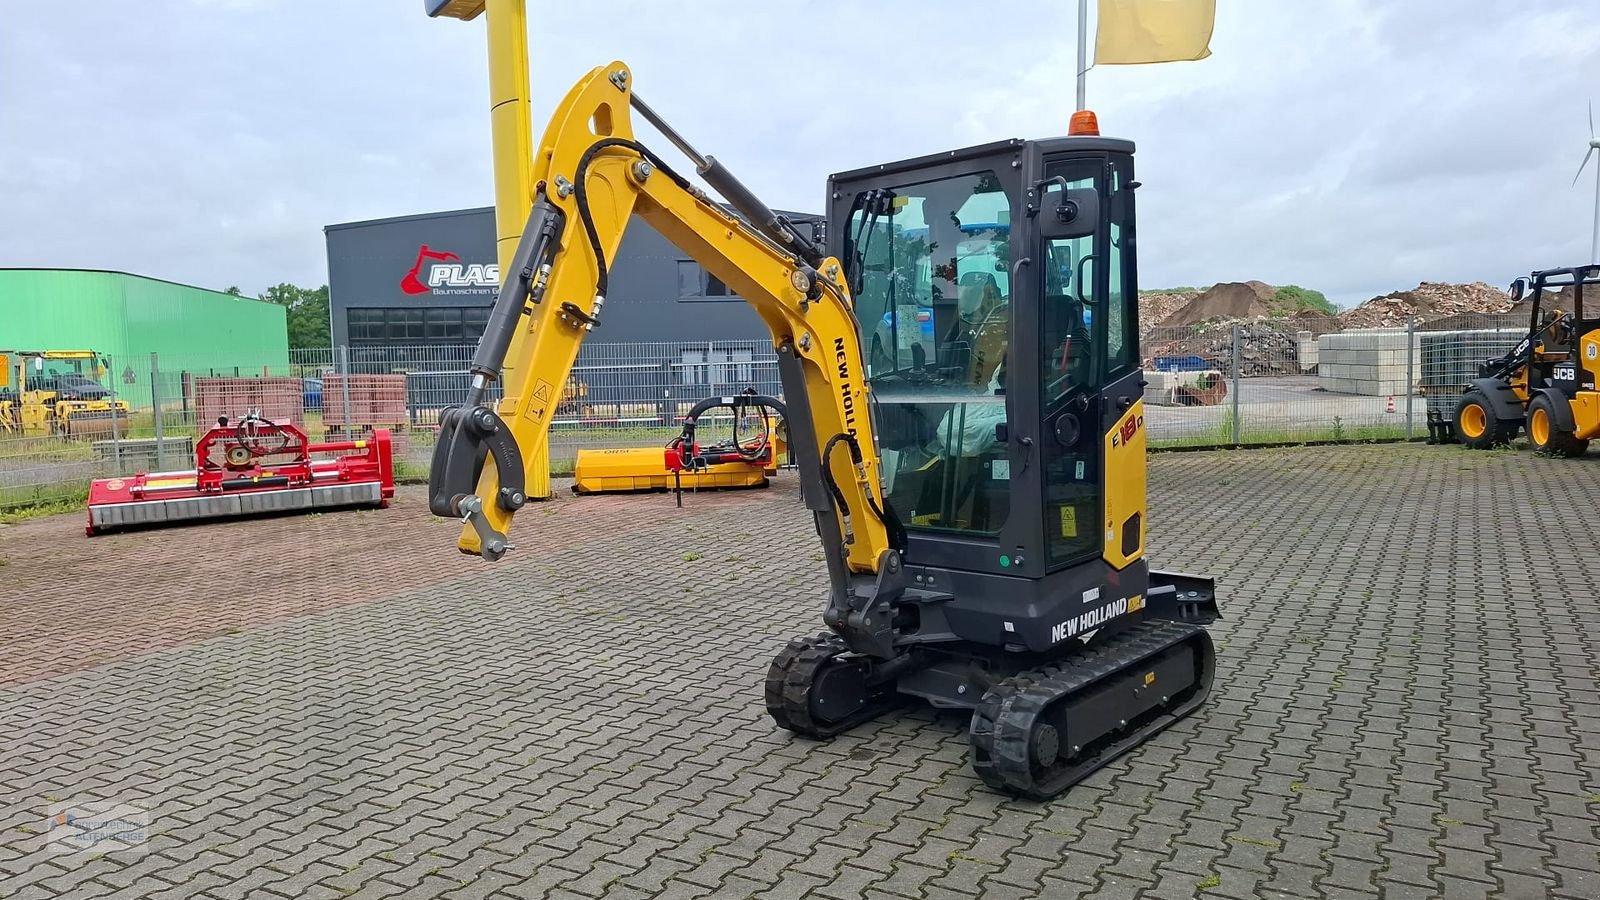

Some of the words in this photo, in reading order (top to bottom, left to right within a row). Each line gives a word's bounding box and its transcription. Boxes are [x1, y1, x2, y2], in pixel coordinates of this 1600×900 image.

[834, 337, 848, 379] NEW
[1514, 339, 1530, 356] JCB
[1553, 368, 1575, 381] JCB
[1051, 616, 1078, 644] NEW
[1079, 598, 1127, 632] HOLLAND
